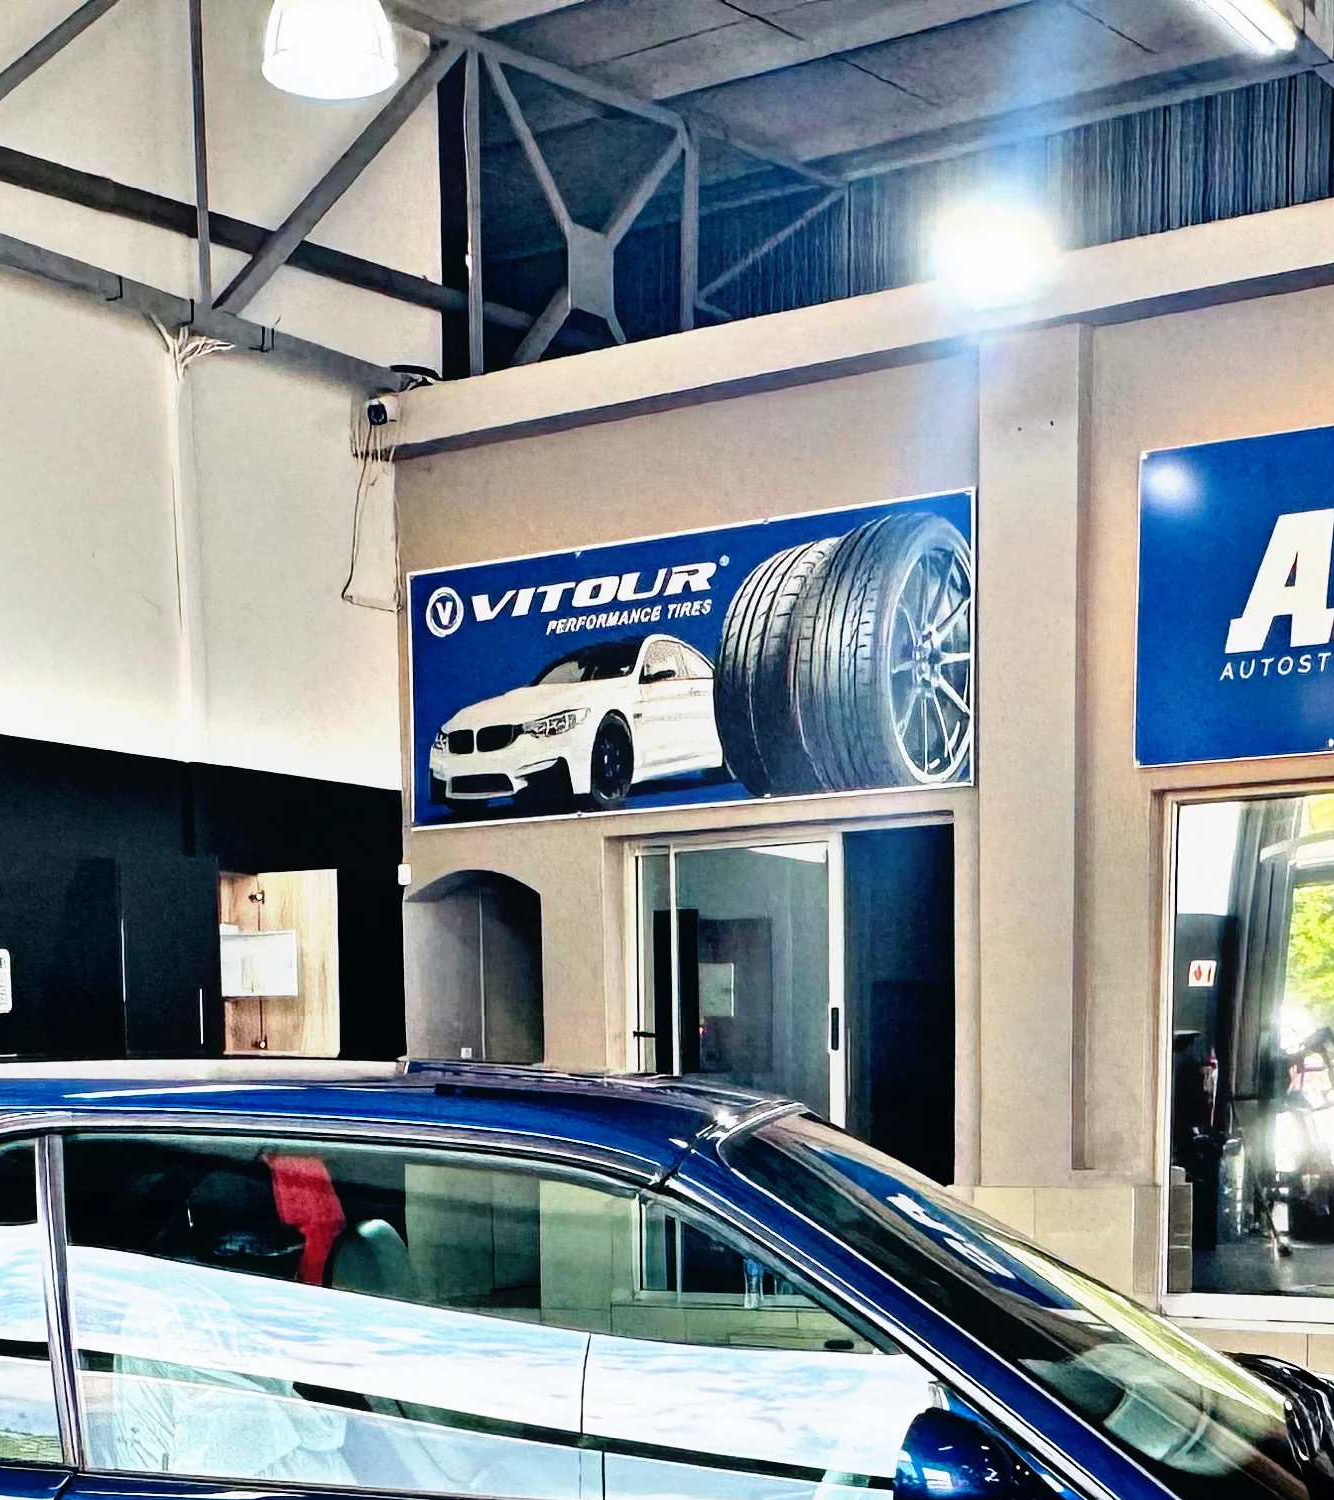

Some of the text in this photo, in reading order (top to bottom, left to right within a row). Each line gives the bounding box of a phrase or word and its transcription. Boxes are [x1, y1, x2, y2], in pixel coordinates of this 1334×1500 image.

[471, 562, 718, 622] VITOUR
[546, 599, 713, 636] PERFORMANCE TIRES
